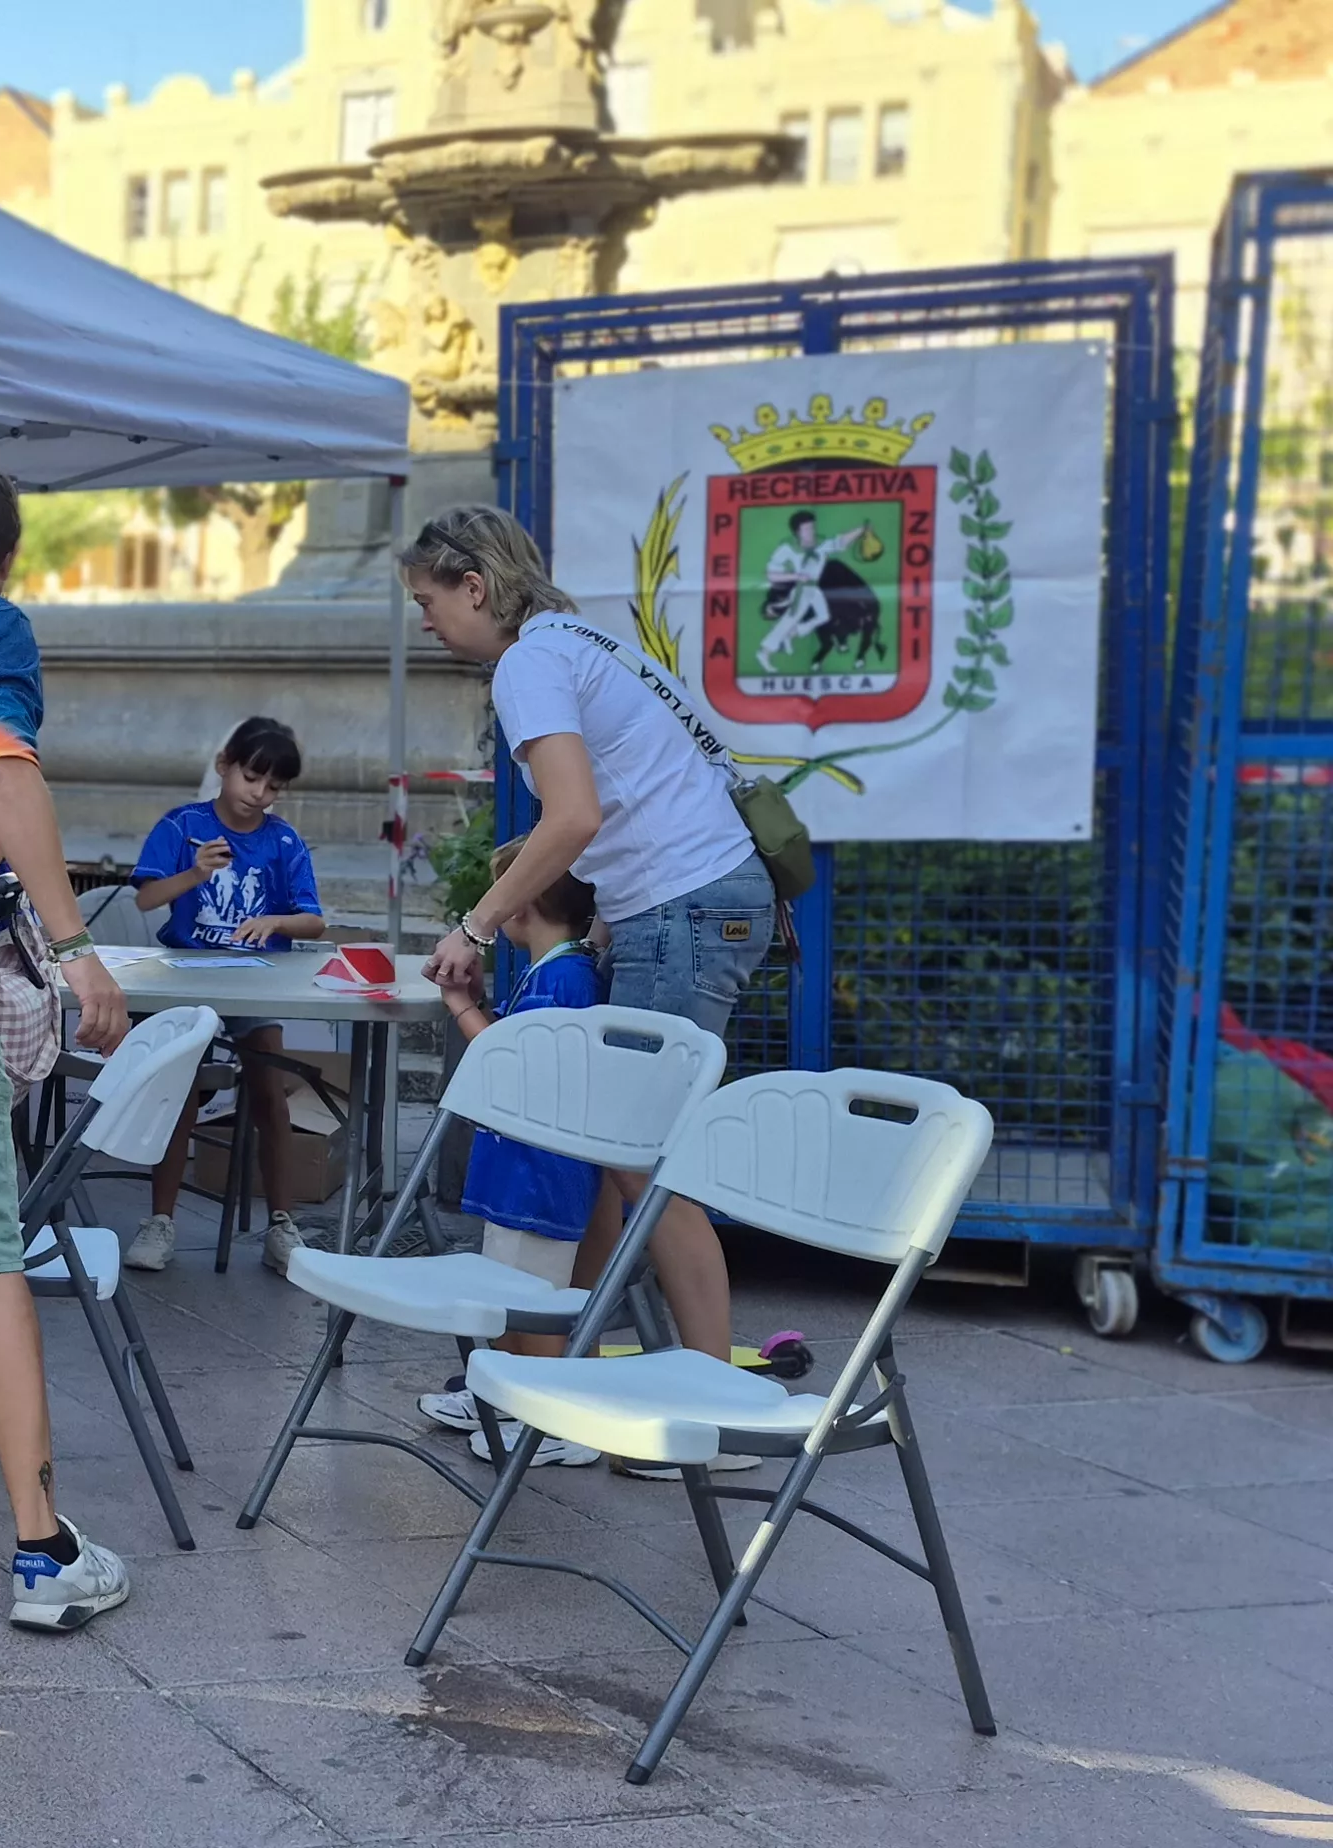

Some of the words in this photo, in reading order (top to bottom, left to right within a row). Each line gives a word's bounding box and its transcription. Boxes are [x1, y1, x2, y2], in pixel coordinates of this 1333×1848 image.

[728, 472, 918, 500] RECREATIVA
[709, 513, 732, 659] PEÑA
[905, 511, 933, 661] ZOITI
[563, 622, 620, 652] BIMBA
[639, 663, 682, 711] LOLA
[761, 676, 873, 691] HUESCA
[680, 713, 694, 728] Y
